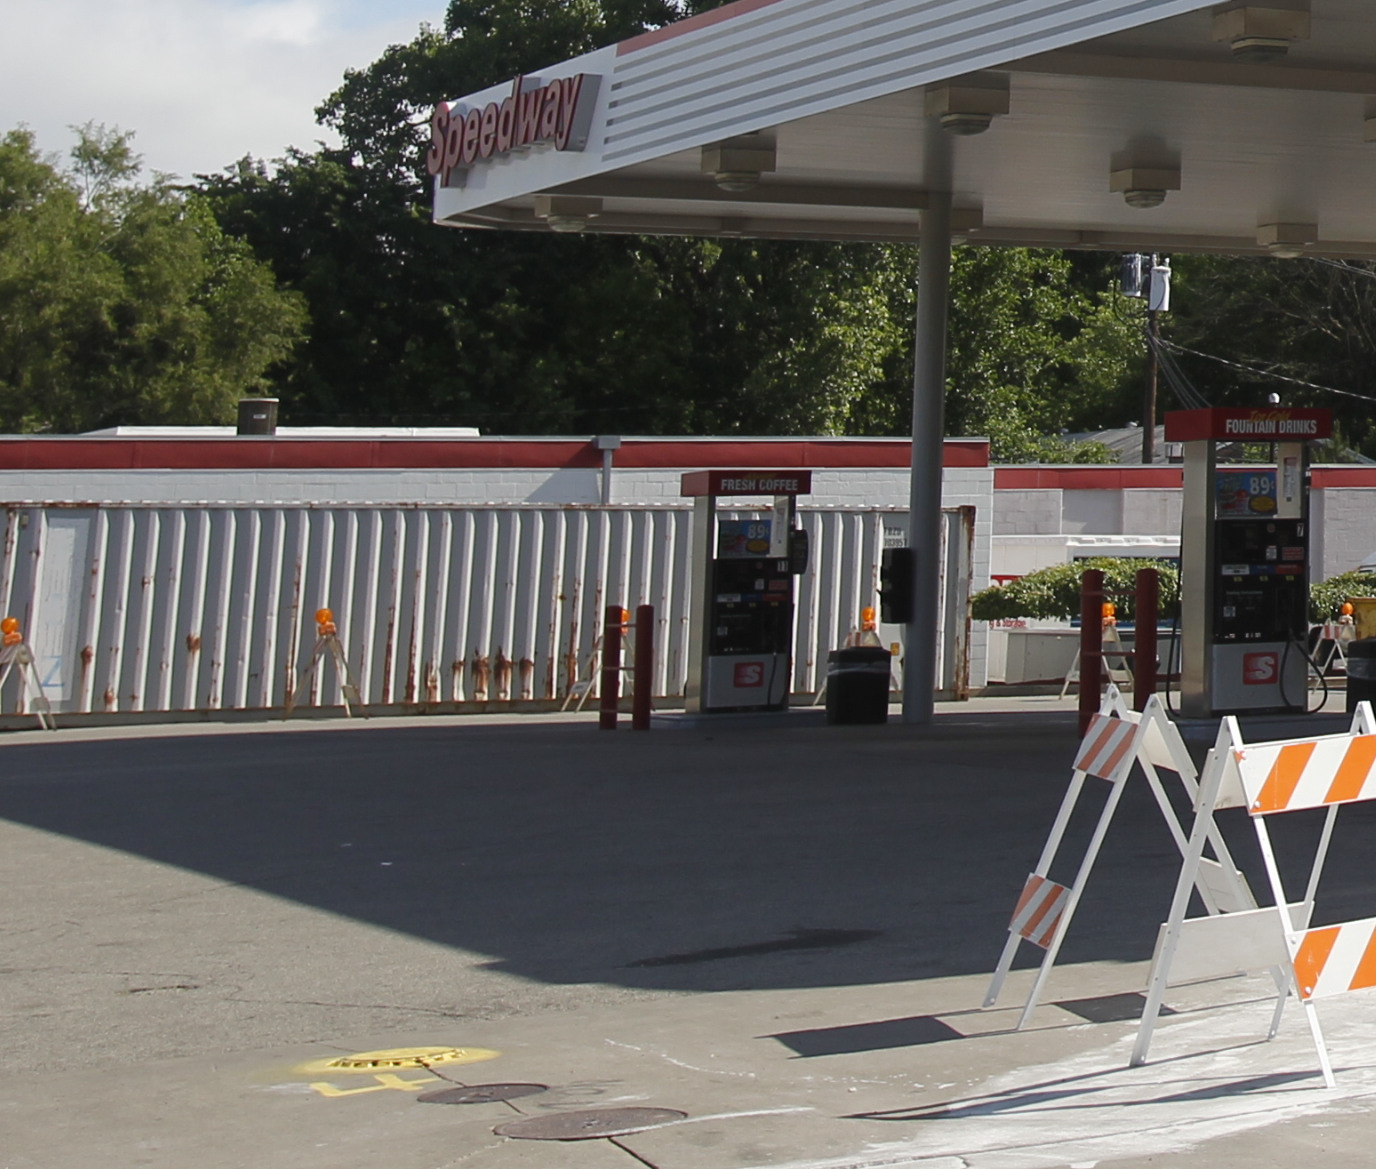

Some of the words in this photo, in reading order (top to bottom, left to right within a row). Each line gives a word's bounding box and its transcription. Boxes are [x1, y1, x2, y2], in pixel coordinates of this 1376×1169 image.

[427, 74, 584, 187] Speedway
[1226, 419, 1276, 433] FOUNTAIN
[1279, 420, 1318, 434] DRINKS
[720, 479, 756, 491] FRESH
[759, 479, 799, 491] COFFEE
